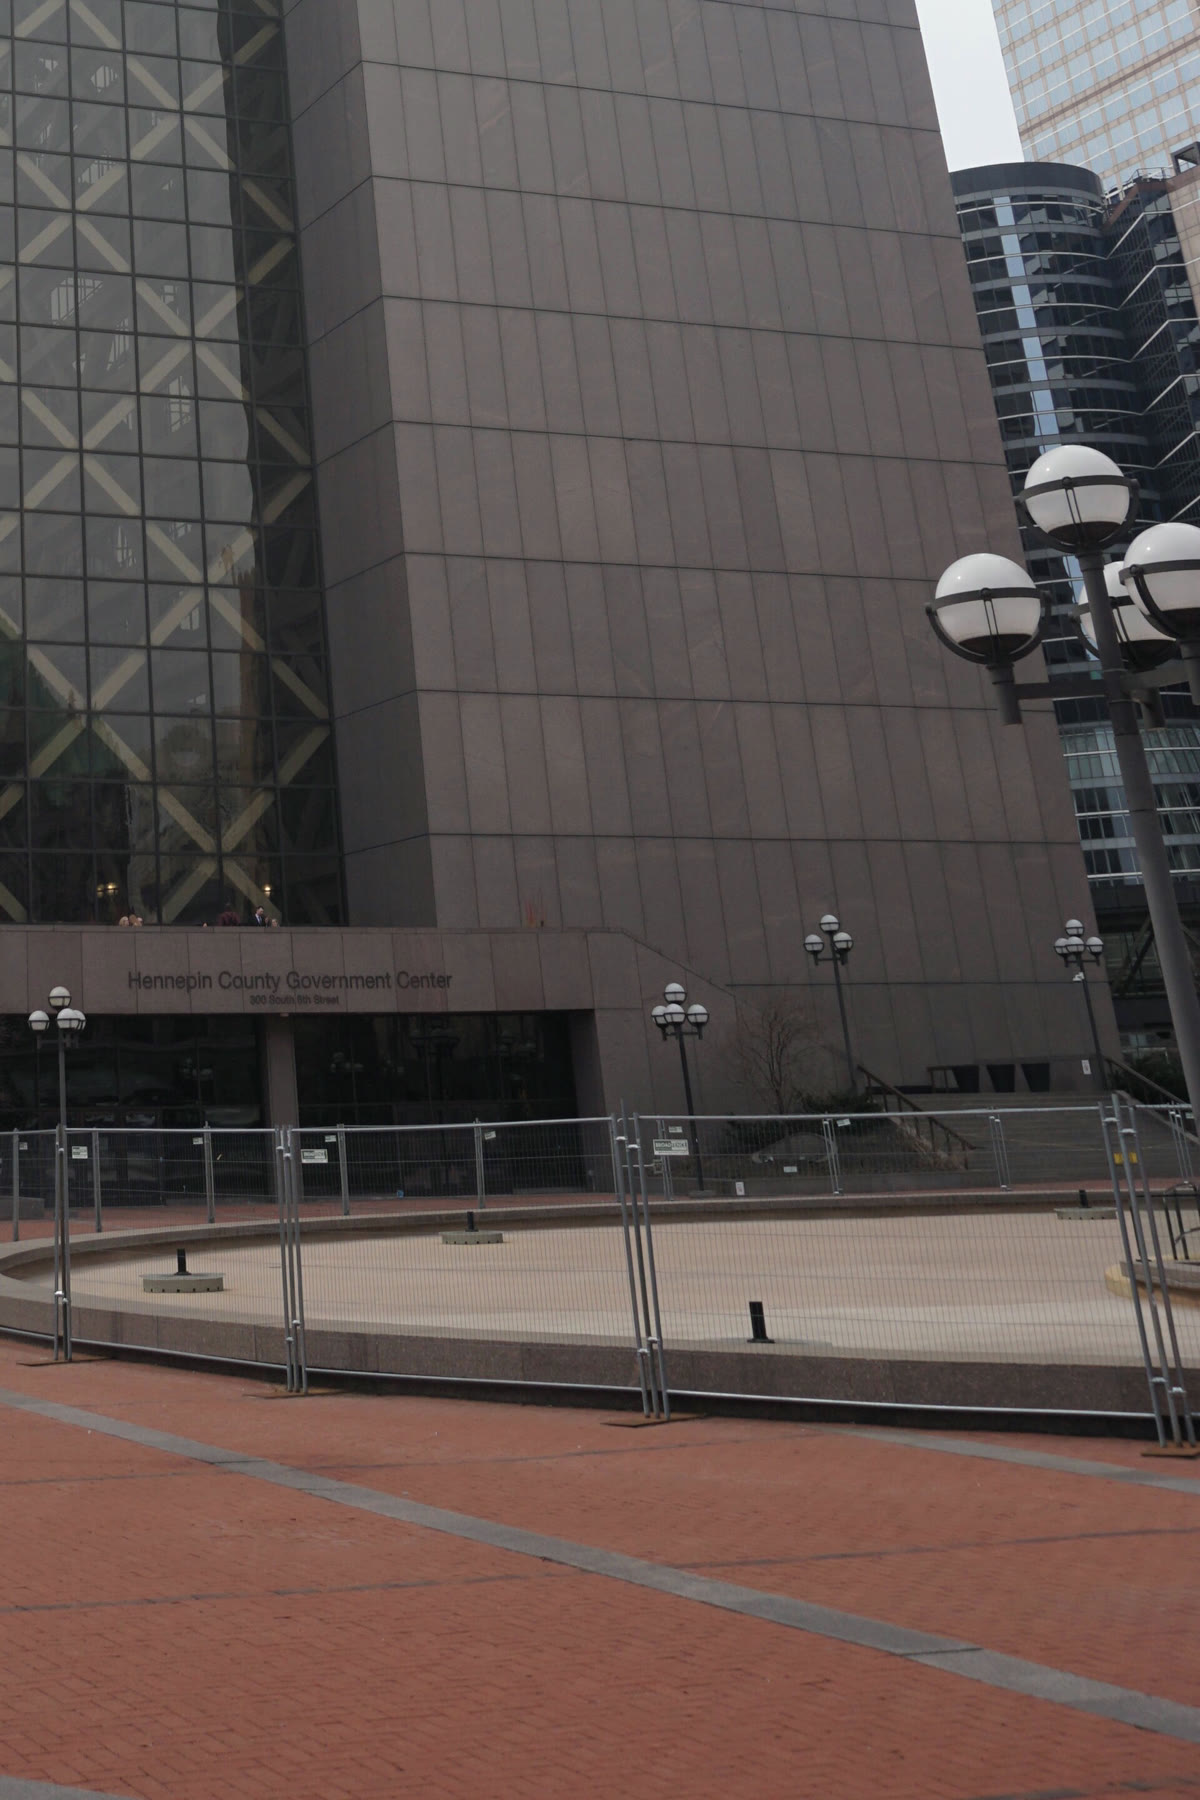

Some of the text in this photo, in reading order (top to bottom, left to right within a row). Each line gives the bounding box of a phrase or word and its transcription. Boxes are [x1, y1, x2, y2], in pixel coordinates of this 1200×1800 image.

[128, 971, 452, 993] Hennepin County Government Center
[249, 994, 267, 1005] 300
[268, 994, 295, 1005] South
[313, 994, 340, 1005] Street
